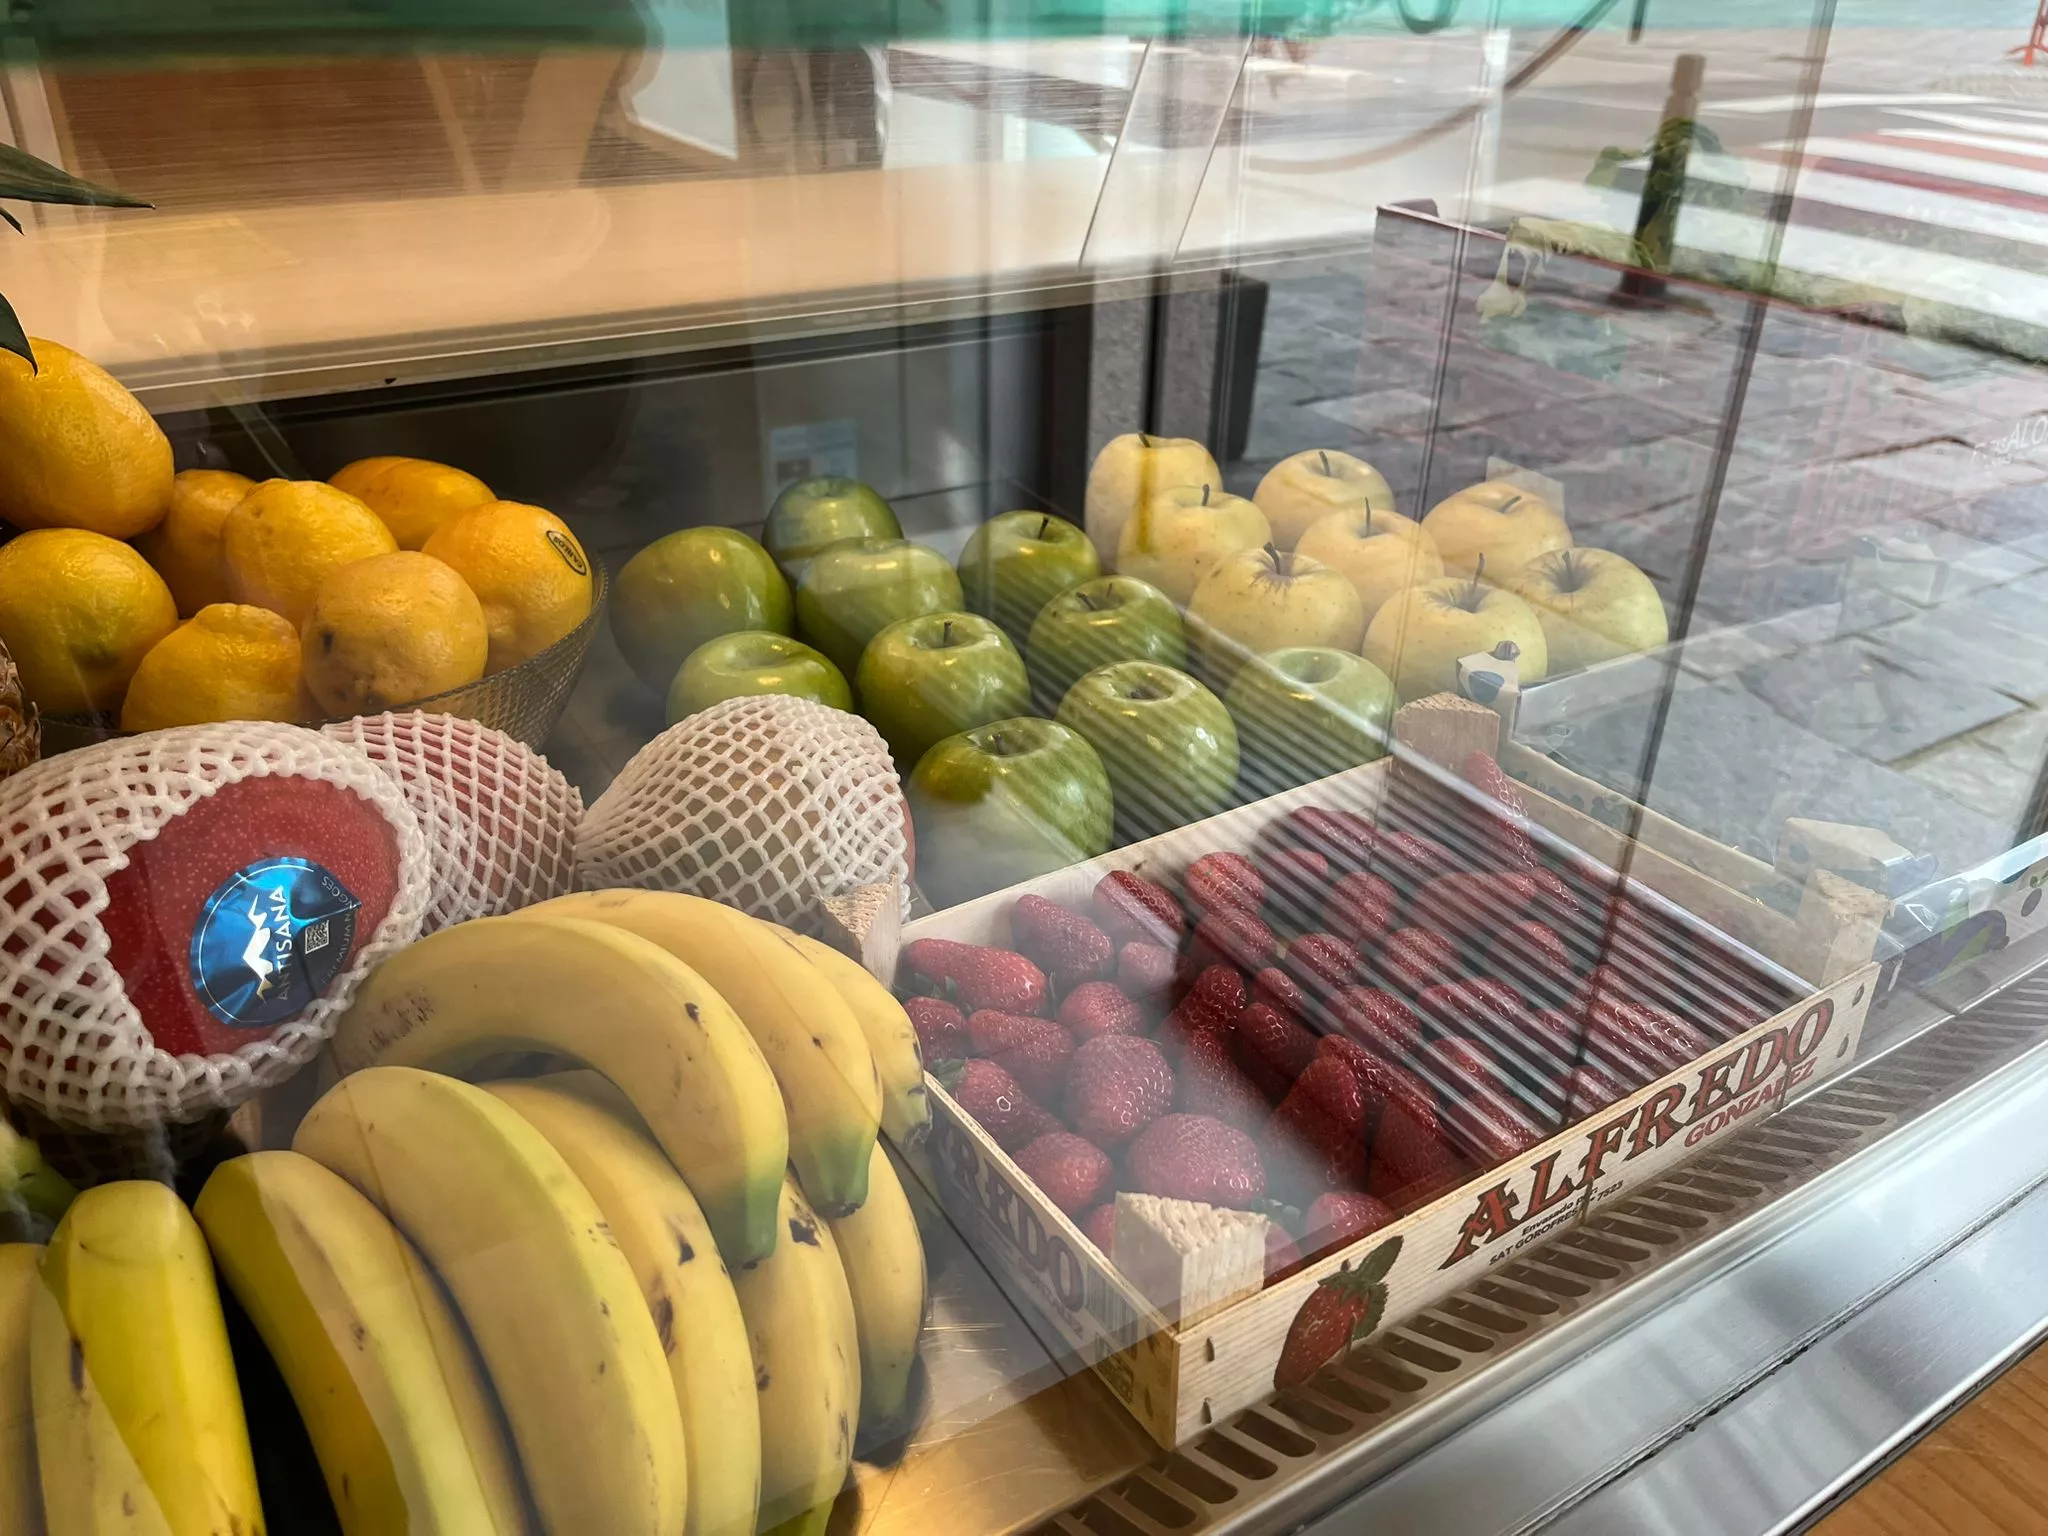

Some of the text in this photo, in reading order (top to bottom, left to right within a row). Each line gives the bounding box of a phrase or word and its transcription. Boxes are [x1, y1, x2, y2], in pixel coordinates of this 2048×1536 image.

[269, 885, 293, 1001] ANTISANA
[1437, 998, 1835, 1271] ALFREDO
[1489, 1245, 1514, 1266] SAT
[1522, 1202, 1573, 1236] Envasado
